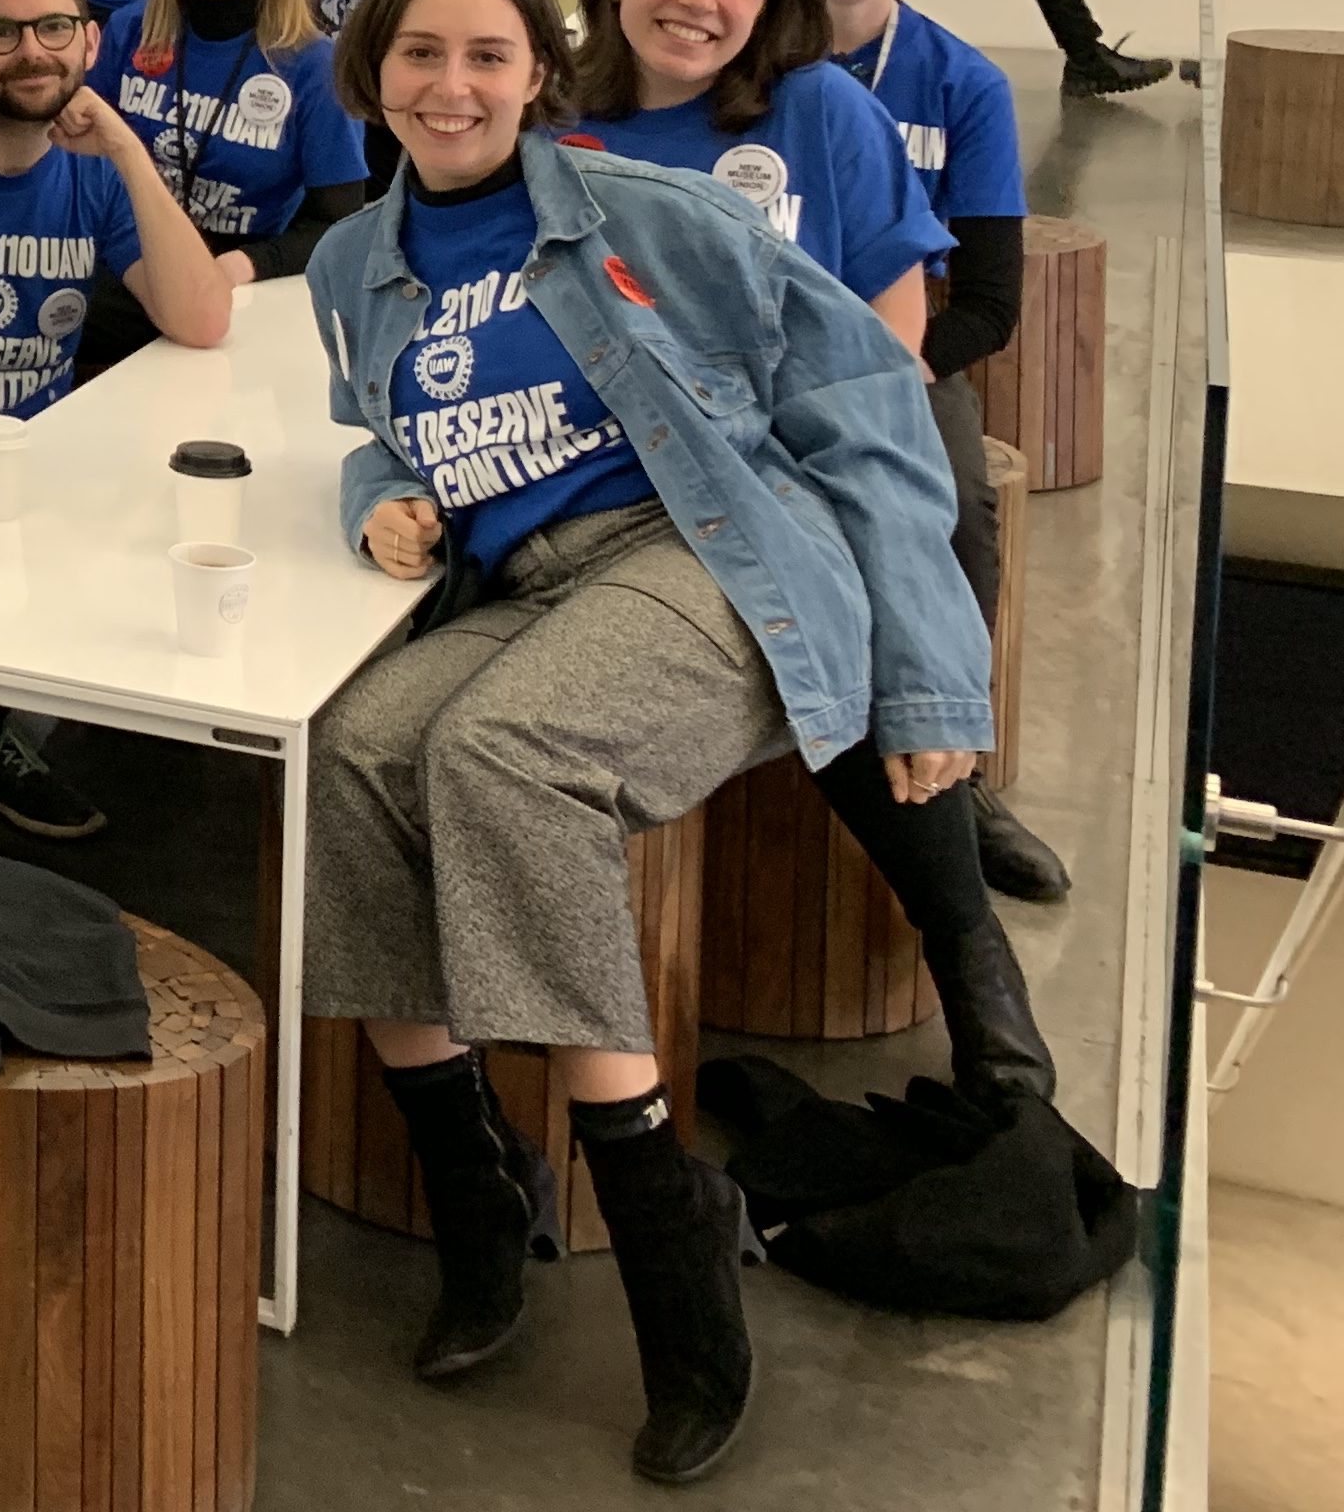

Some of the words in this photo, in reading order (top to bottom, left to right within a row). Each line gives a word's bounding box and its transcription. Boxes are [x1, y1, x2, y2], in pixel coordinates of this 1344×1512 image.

[40, 235, 96, 280] UAW
[431, 270, 500, 336] 2110
[428, 355, 458, 376] UAW
[416, 381, 575, 466] DESERVE
